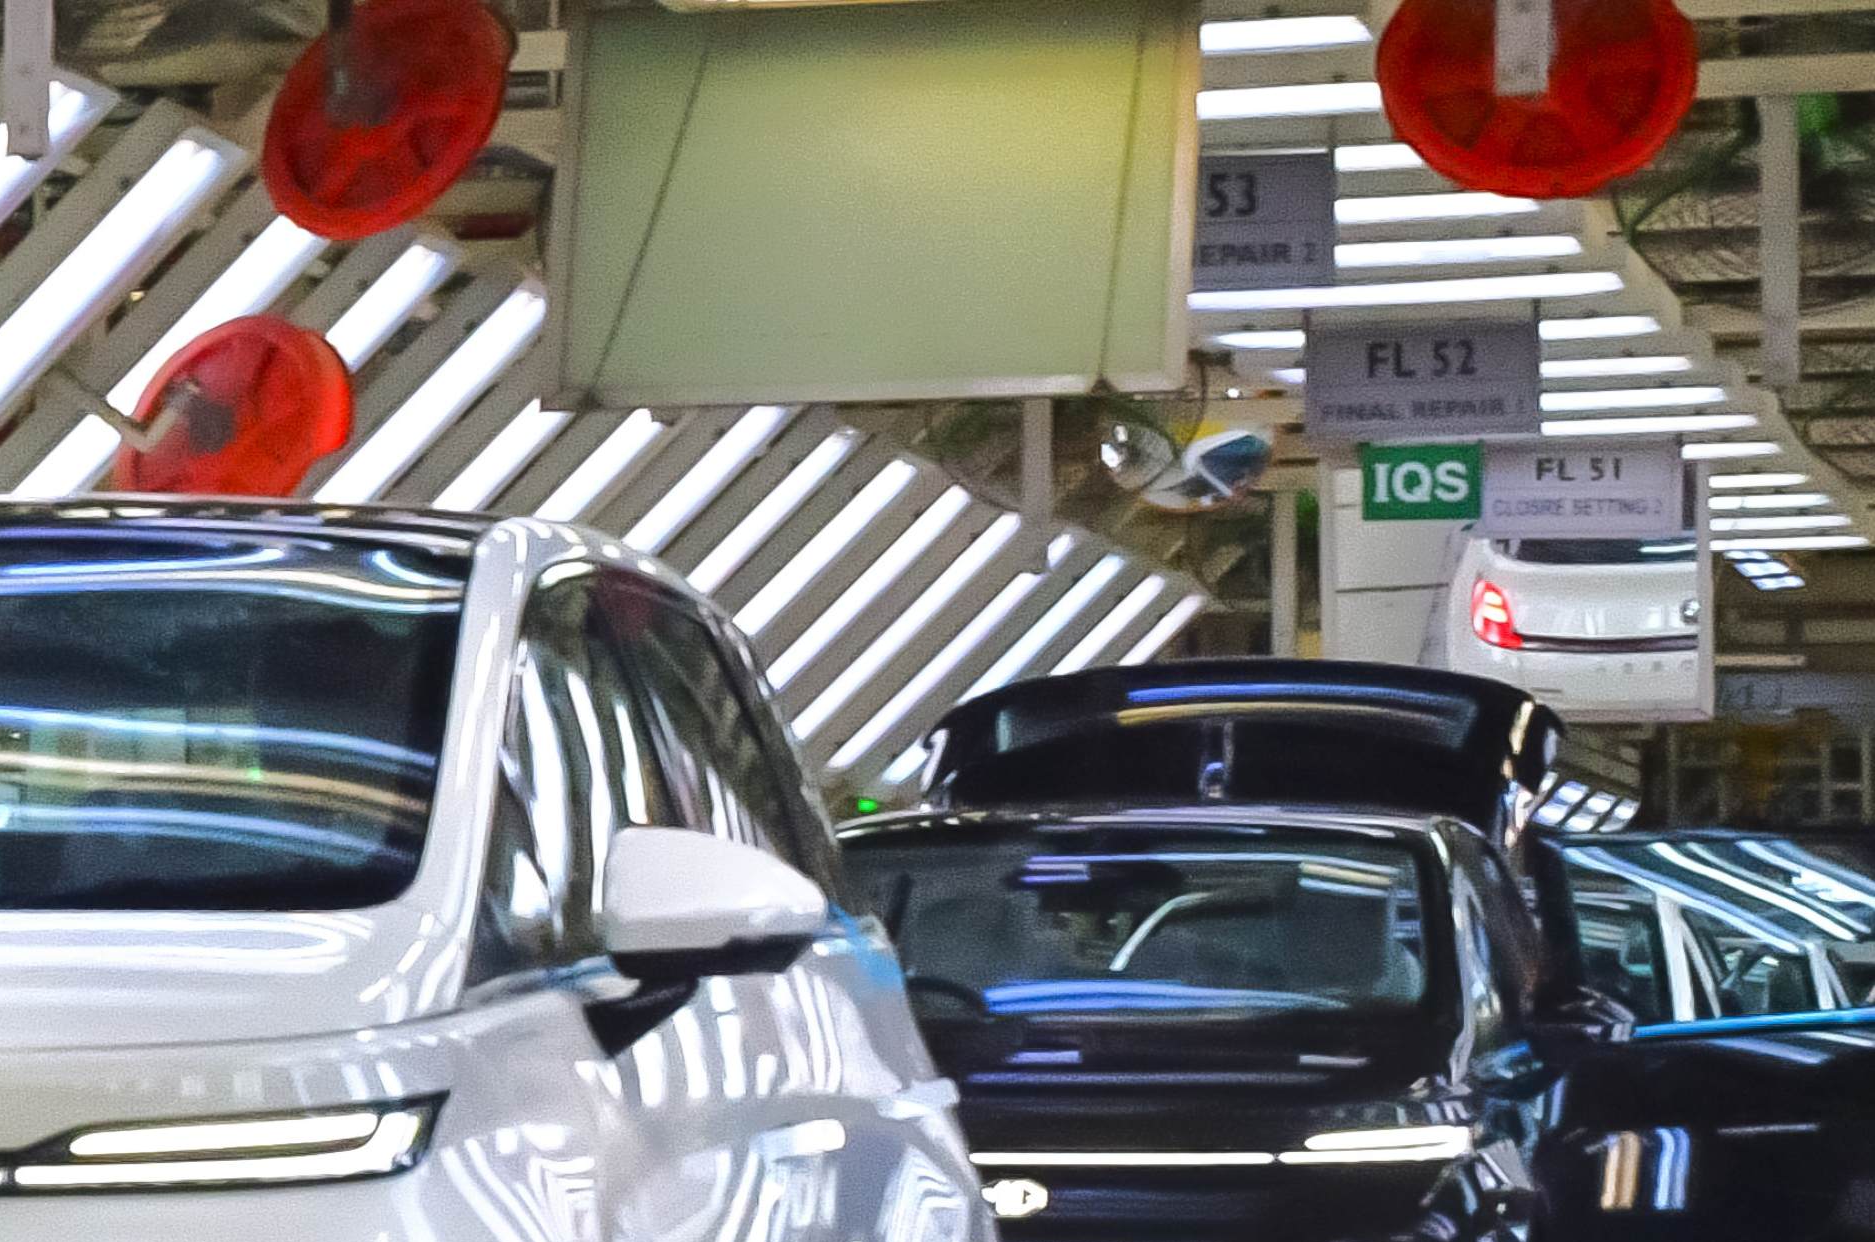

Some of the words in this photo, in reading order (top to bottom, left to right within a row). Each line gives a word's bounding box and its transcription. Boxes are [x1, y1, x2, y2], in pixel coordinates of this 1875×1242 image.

[1209, 172, 1256, 217] 53
[1199, 243, 1291, 267] EPAIR
[1368, 341, 1416, 379] FL
[1433, 339, 1477, 377] 52
[1412, 399, 1504, 419] REPAIR
[1375, 461, 1470, 503] IQS
[1536, 457, 1575, 481] FL
[1590, 457, 1622, 480] 51
